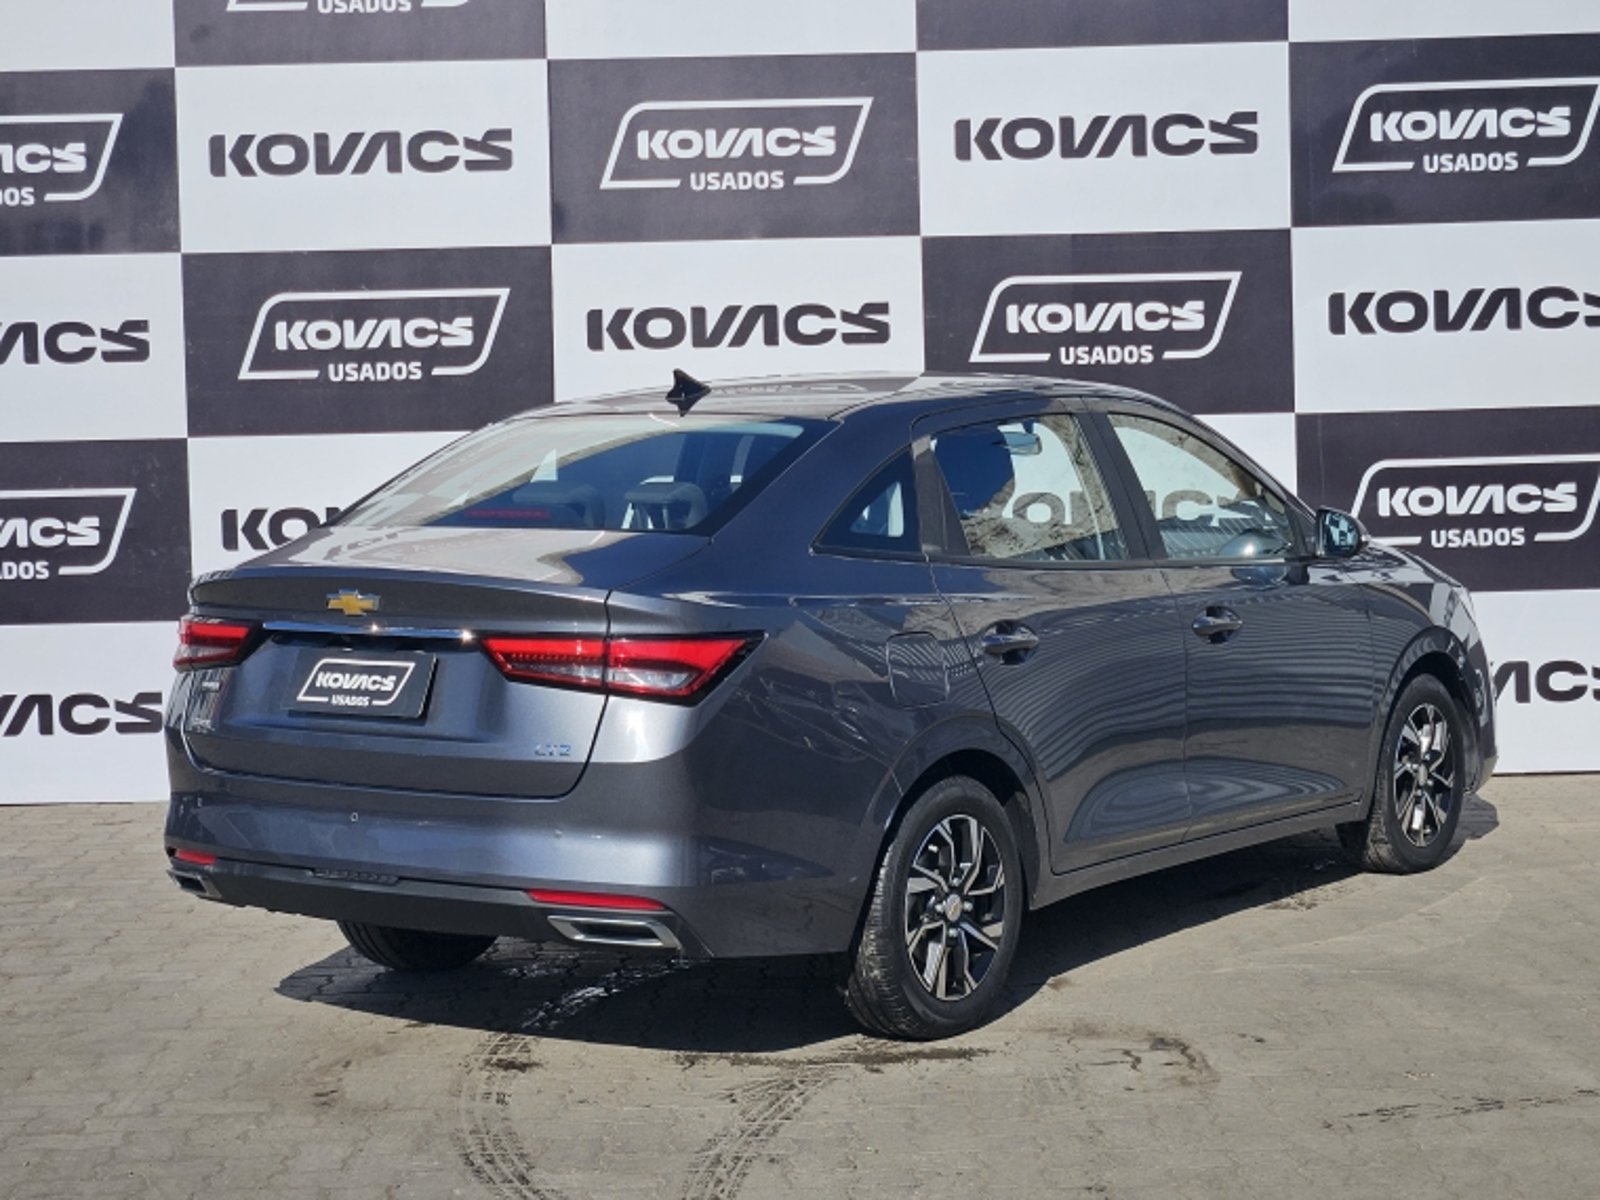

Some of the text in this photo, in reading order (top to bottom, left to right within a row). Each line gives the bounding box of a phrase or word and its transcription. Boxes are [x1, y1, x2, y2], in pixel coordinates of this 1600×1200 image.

[318, 0, 412, 14] USADOS
[954, 111, 1258, 161] KOVACS
[1371, 107, 1571, 141] KOVACS
[208, 128, 513, 177] KOVACS
[637, 126, 836, 160] KOVACS
[1423, 152, 1519, 174] USADOS
[690, 171, 784, 191] USADOS
[586, 302, 891, 351] KOVACS
[1006, 301, 1205, 334] KOVACS
[0, 320, 150, 364] ACS
[275, 317, 474, 351] KOVACS
[1060, 345, 1154, 365] USADOS
[328, 362, 422, 382] USADOS
[1378, 483, 1577, 516] KOVACS
[0, 516, 100, 548] ACS
[1431, 528, 1526, 548] USADOS
[0, 560, 50, 580] DOS
[315, 672, 397, 691] KOVACS
[331, 695, 371, 707] USADOS
